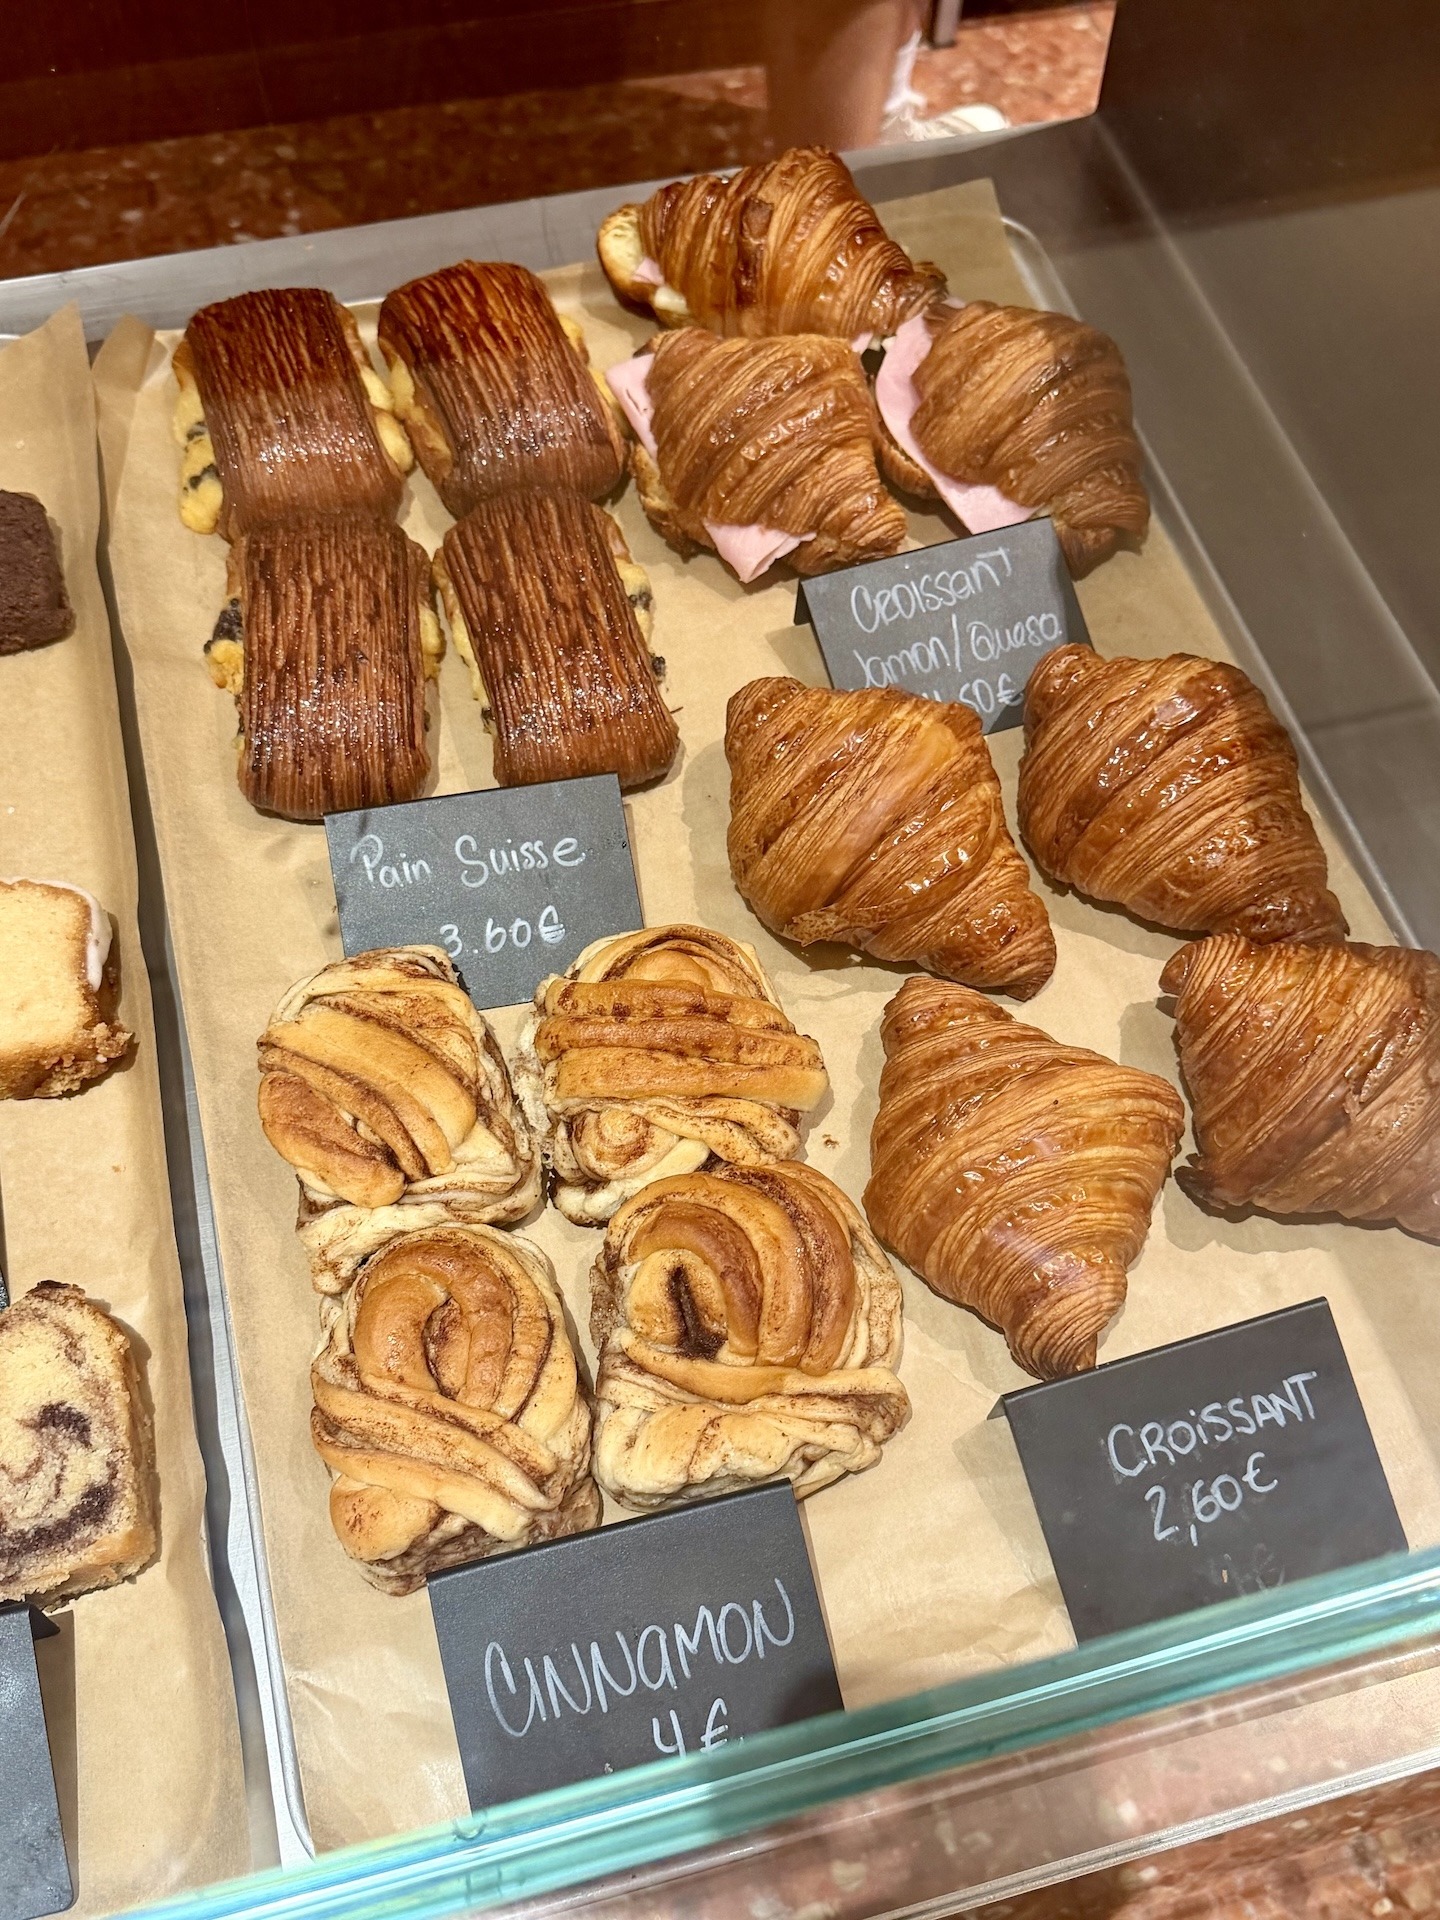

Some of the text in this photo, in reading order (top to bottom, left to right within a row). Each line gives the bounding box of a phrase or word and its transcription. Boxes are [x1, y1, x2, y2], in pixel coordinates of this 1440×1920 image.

[352, 834, 586, 889] Pain Suisse
[439, 905, 566, 957] 3.60€
[1144, 1451, 1278, 1547] 2,60€
